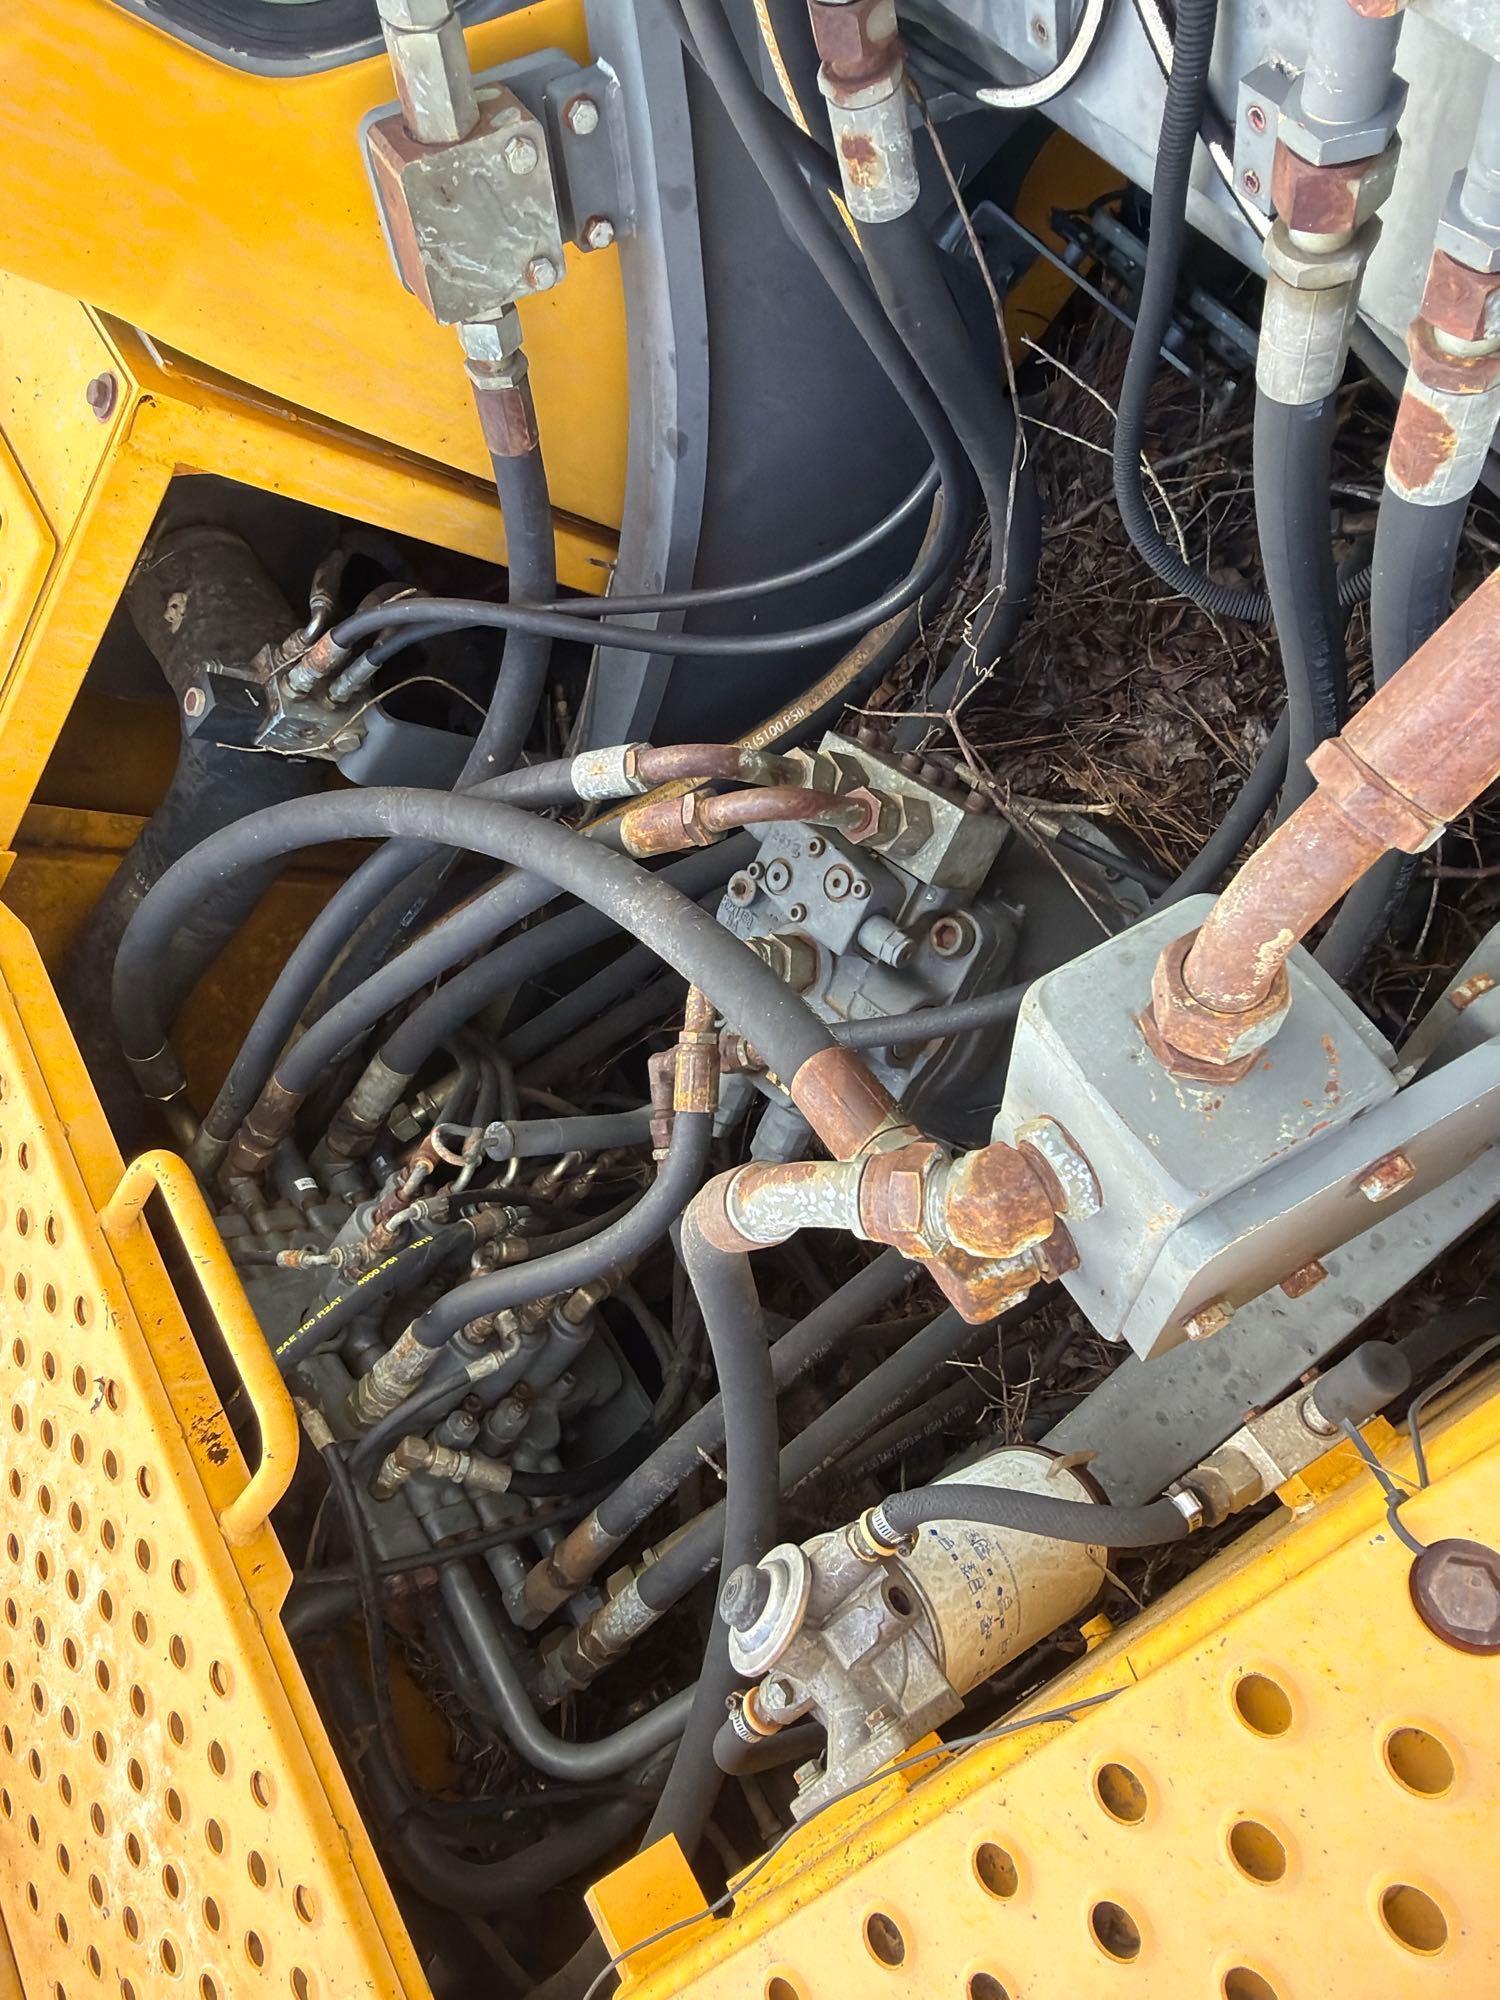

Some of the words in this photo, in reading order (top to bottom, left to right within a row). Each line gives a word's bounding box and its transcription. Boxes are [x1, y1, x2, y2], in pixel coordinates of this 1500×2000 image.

[752, 720, 784, 747] (5100
[783, 706, 805, 727] PSI)
[275, 1334, 297, 1356] SAE
[298, 1318, 316, 1334] 100
[316, 1295, 343, 1319] R2AT
[357, 1268, 380, 1286] 4000
[380, 1256, 399, 1270] PSI
